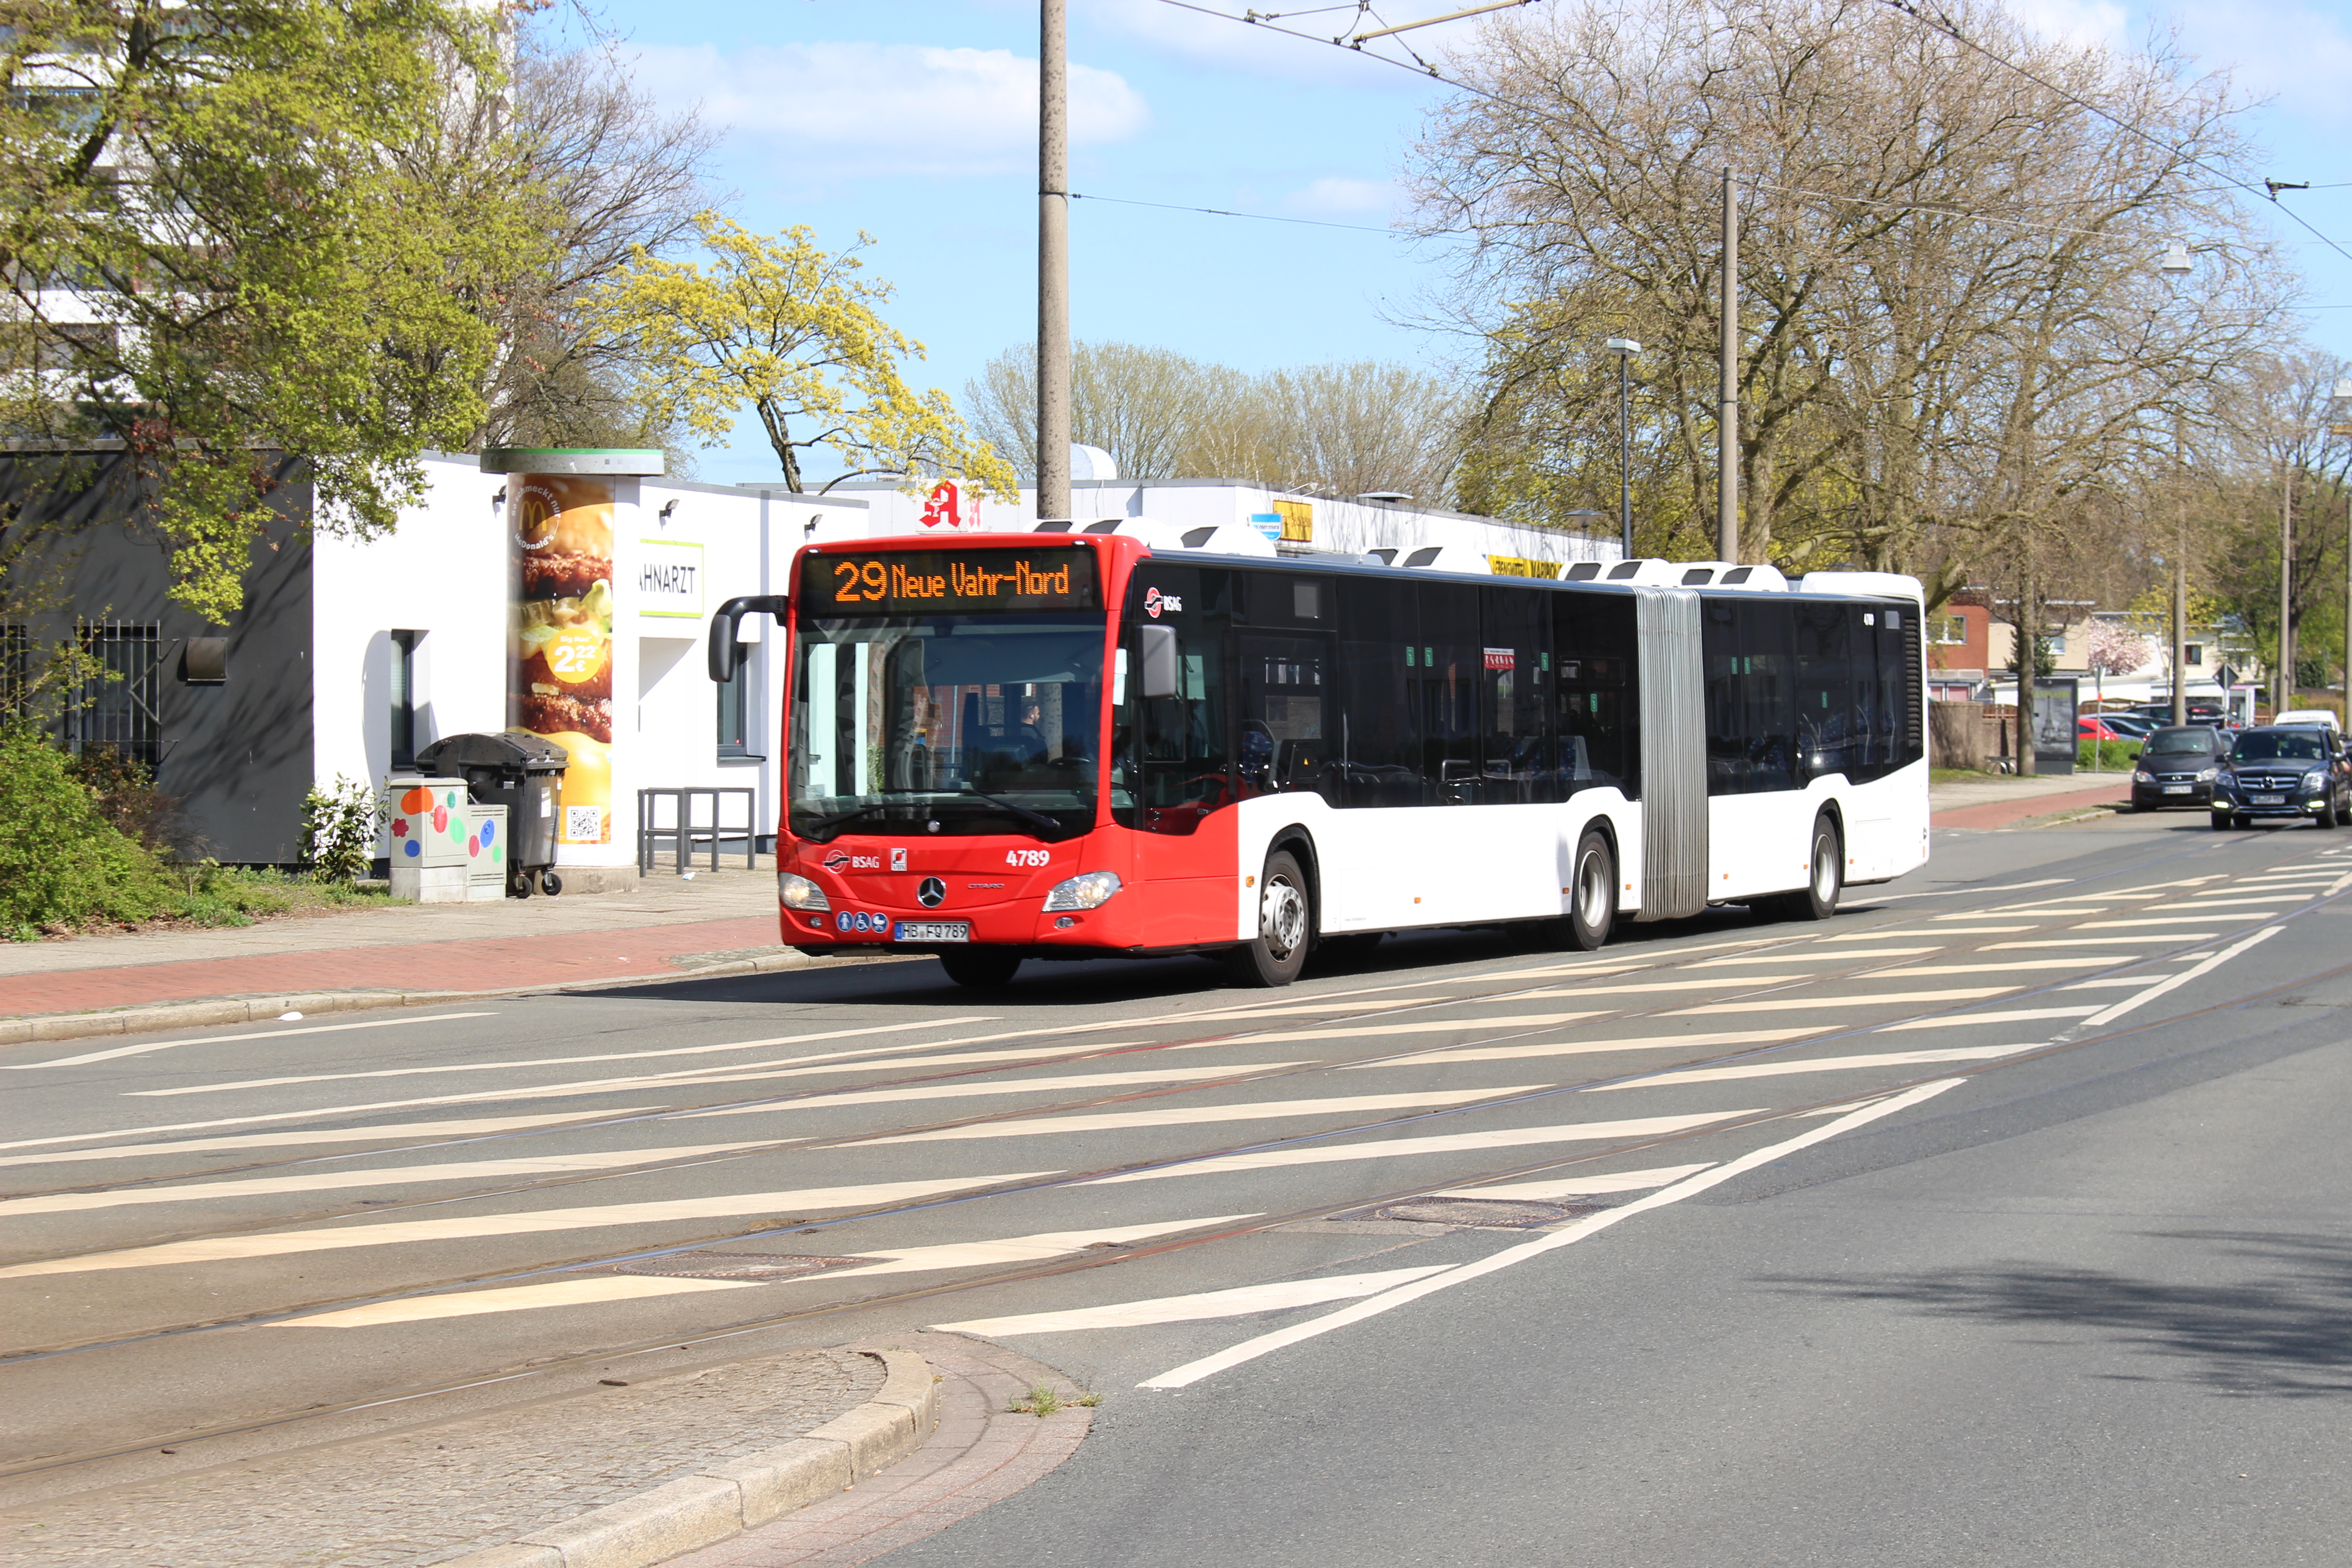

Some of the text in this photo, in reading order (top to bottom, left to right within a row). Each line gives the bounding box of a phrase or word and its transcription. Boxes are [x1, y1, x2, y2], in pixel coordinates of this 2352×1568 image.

[515, 485, 553, 502] schmeckt
[551, 500, 561, 518] nur
[514, 533, 554, 550] McDonald's
[834, 561, 1069, 602] 29 Neue Vahr-Nord
[1163, 596, 1182, 612] BSAG
[852, 856, 880, 868] BSAG
[1005, 850, 1050, 867] 4789
[903, 925, 918, 938] HB
[944, 925, 967, 938] 789
